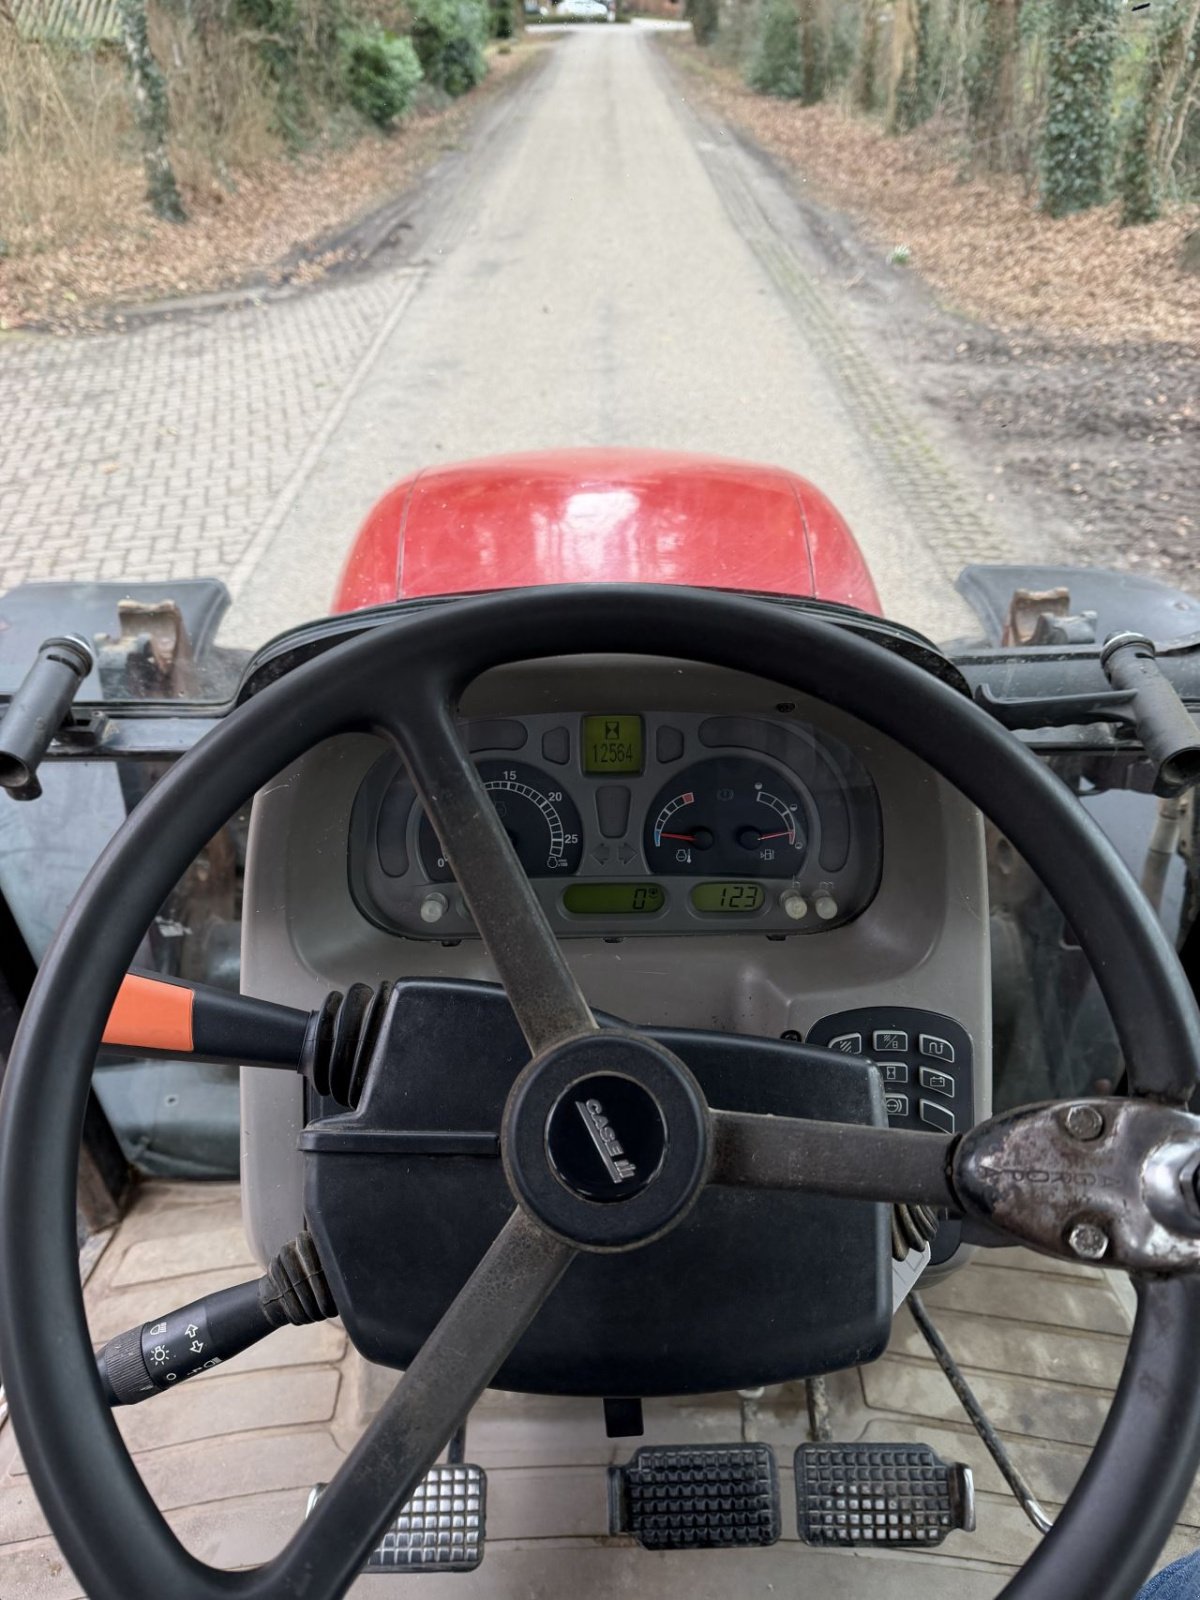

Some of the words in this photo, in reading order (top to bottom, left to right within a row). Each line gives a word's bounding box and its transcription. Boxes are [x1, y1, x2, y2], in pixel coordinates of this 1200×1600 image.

[592, 743, 633, 763] 12564
[503, 771, 517, 780] 15
[548, 792, 562, 801] 20
[564, 834, 578, 844] 25
[437, 857, 445, 868] 0
[720, 886, 758, 908] 123
[586, 1099, 624, 1157] CASE
